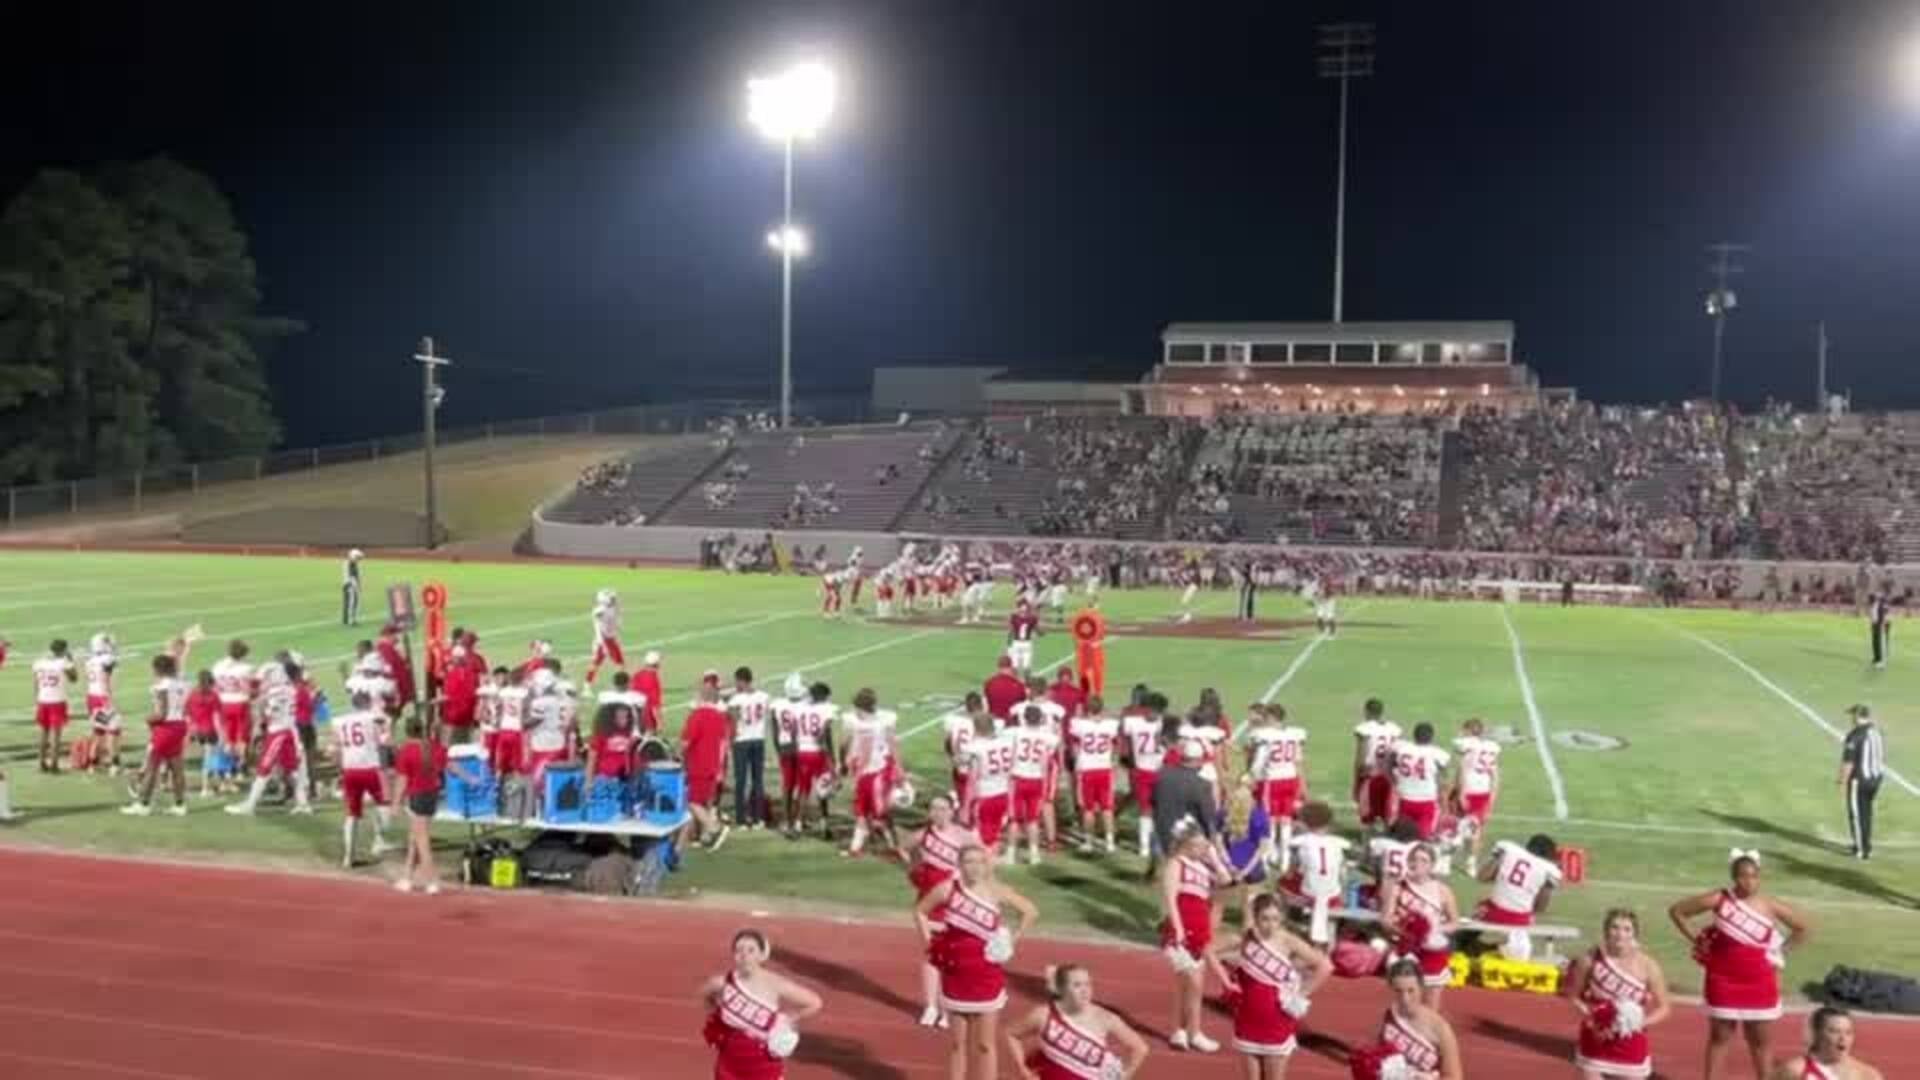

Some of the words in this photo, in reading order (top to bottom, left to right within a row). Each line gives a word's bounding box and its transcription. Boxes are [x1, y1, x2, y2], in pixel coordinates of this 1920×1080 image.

[341, 722, 364, 747] 16
[801, 712, 821, 738] 18
[1019, 738, 1044, 764] 35
[1082, 734, 1111, 755] 22
[1268, 740, 1297, 763] 20
[1399, 755, 1426, 781] 64
[1318, 847, 1328, 876] 1
[1508, 859, 1531, 887] 6
[1046, 1018, 1104, 1065] VSHS
